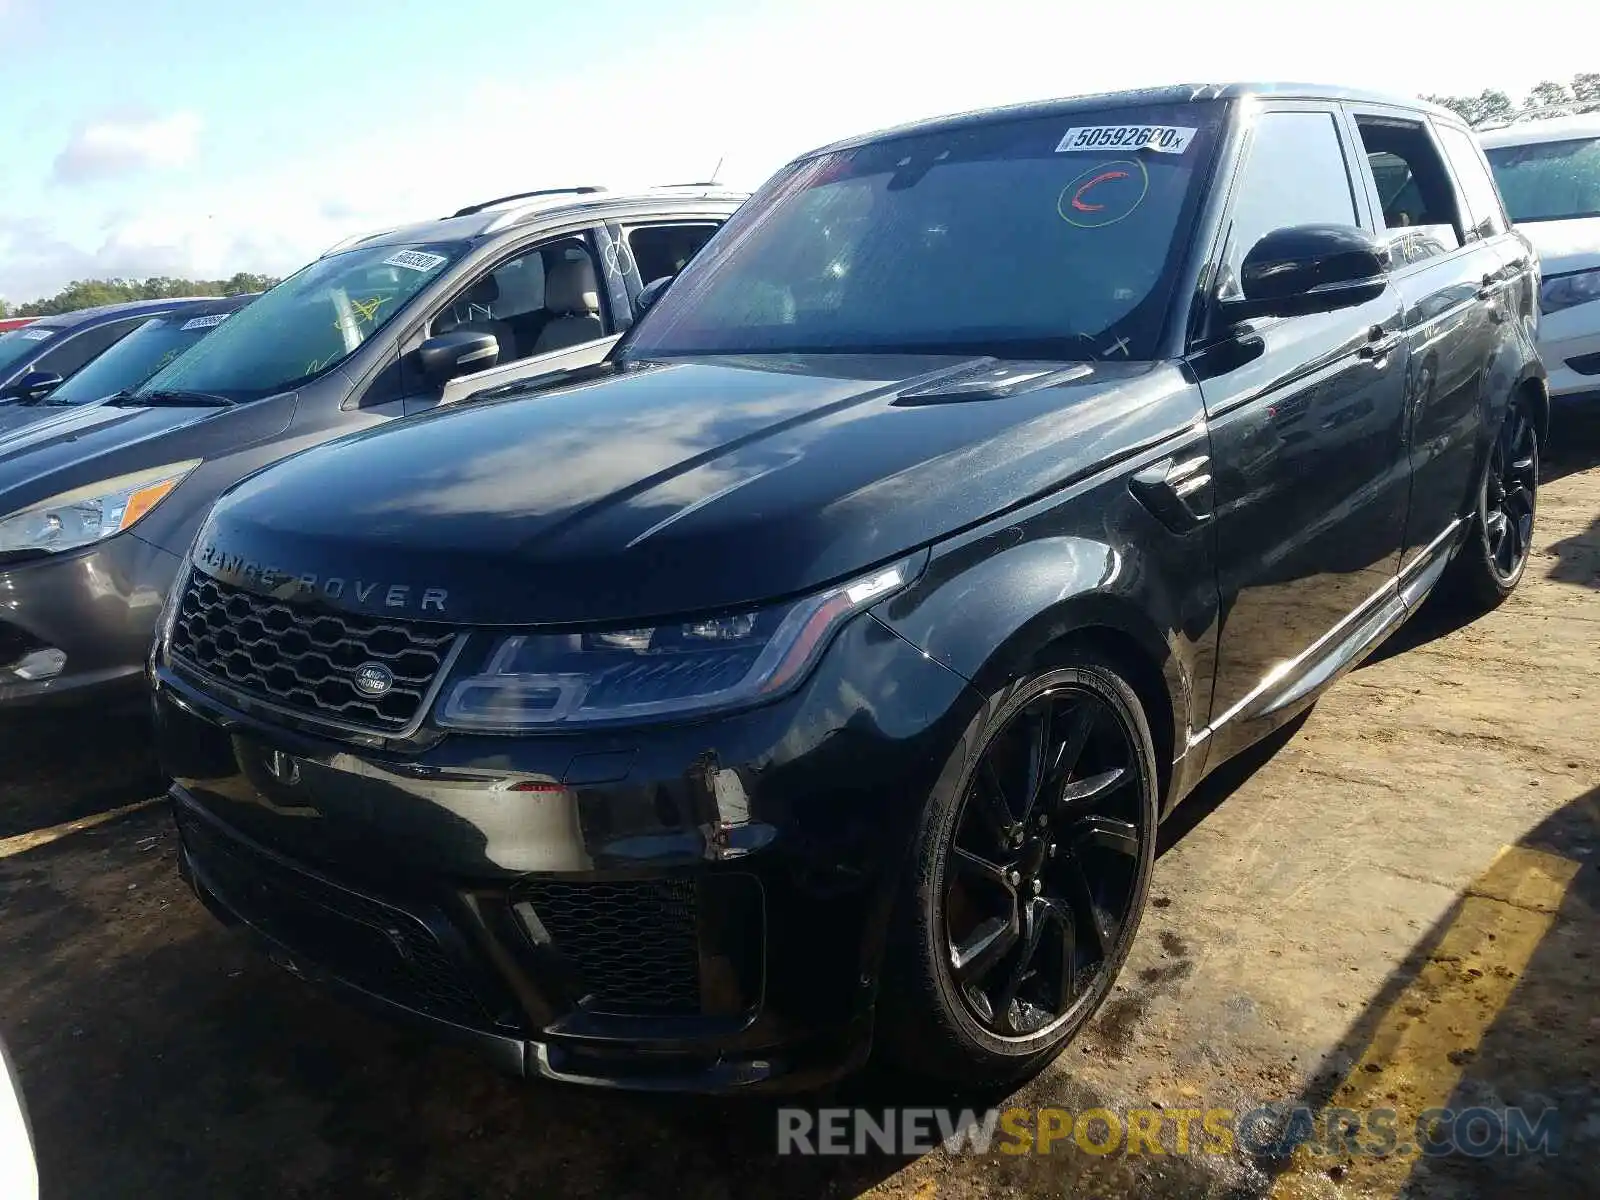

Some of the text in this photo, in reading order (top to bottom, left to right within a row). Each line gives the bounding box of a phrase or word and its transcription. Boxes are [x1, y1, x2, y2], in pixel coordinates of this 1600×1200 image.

[202, 544, 449, 611] RANGE ROVER
[361, 668, 382, 680] LAND
[360, 678, 385, 690] ROVER
